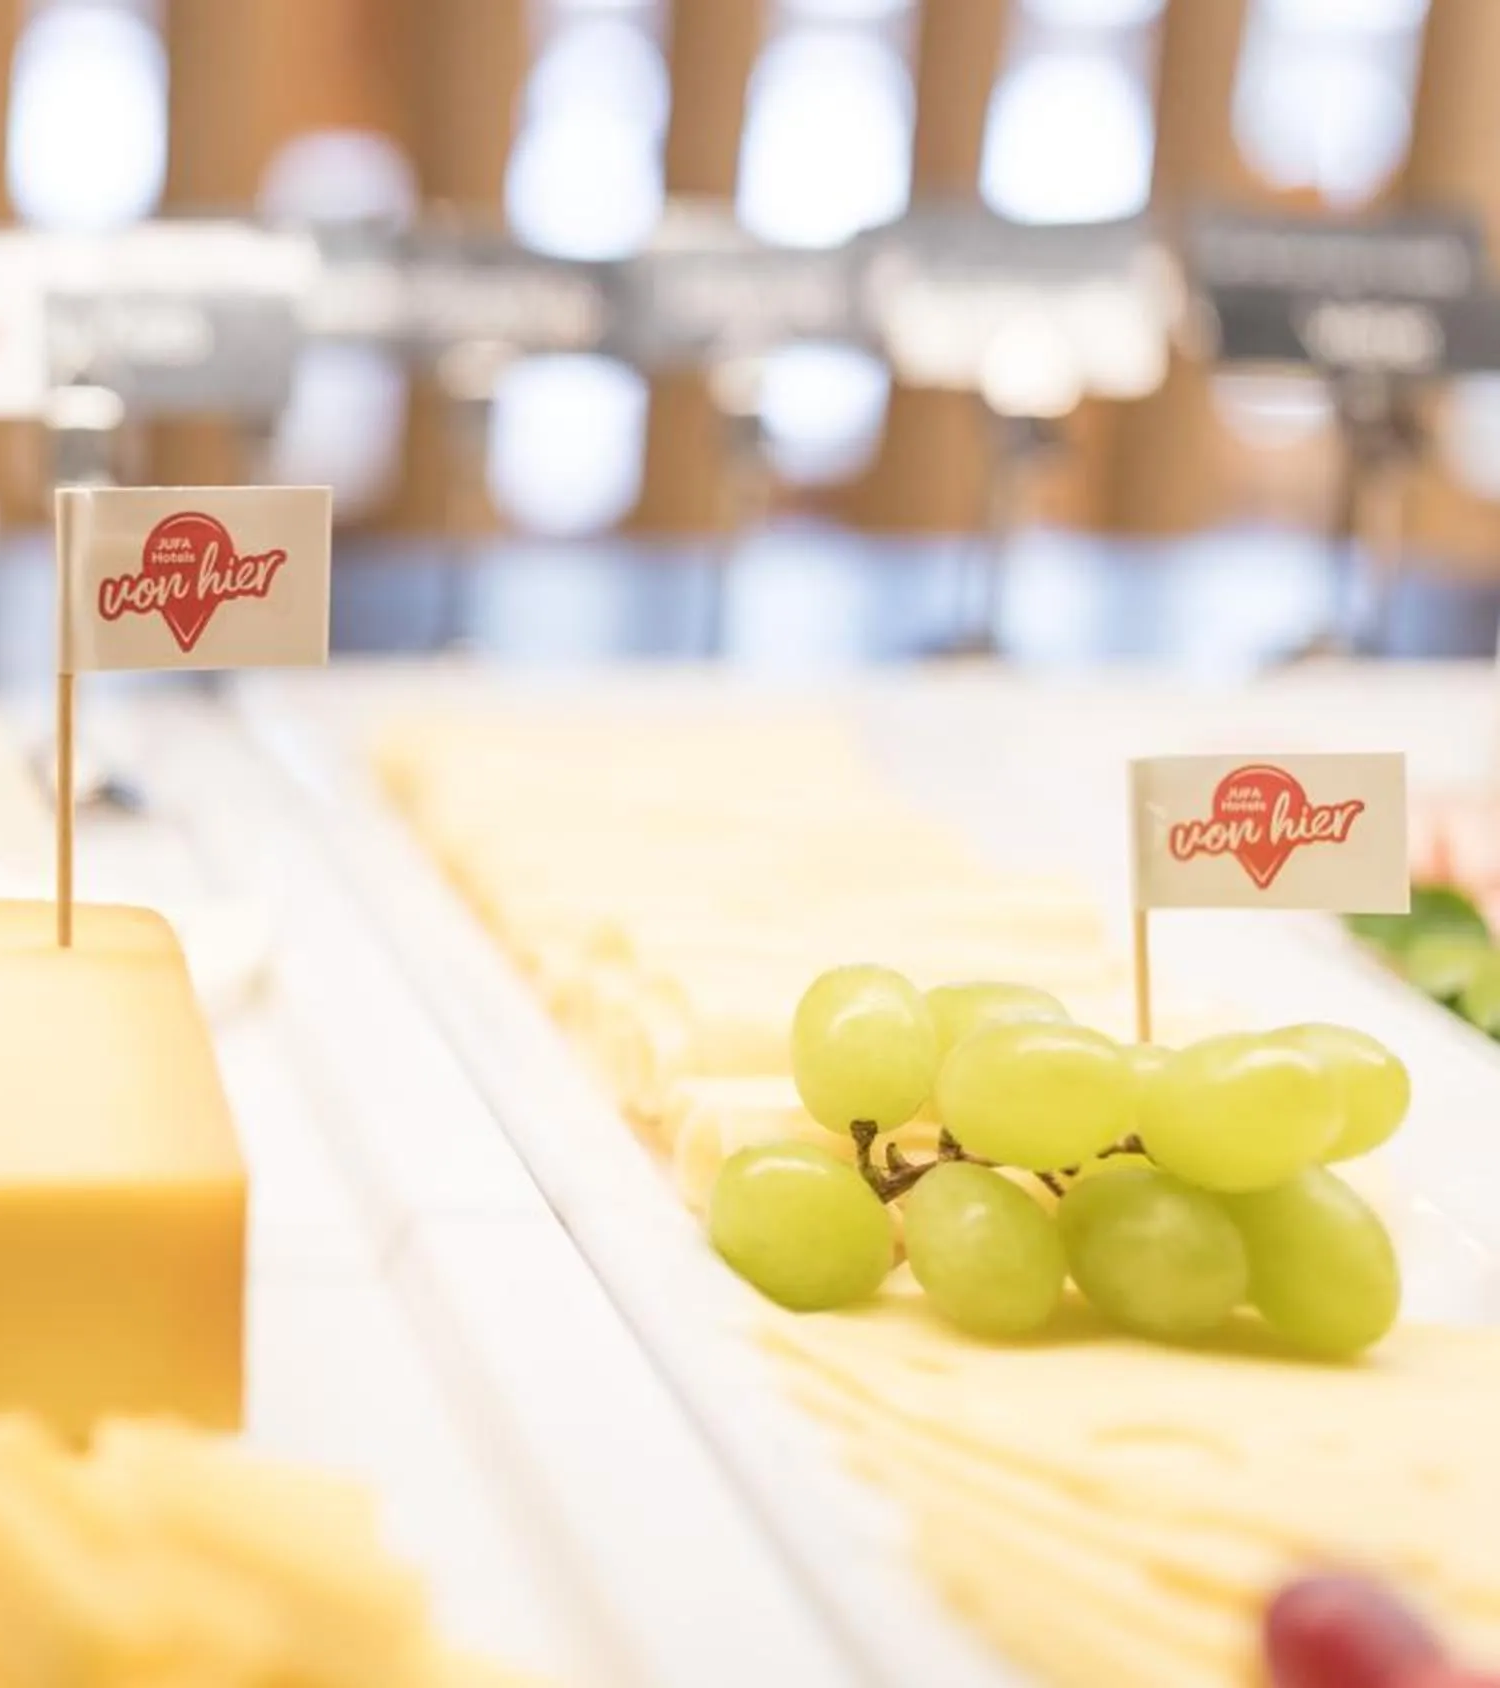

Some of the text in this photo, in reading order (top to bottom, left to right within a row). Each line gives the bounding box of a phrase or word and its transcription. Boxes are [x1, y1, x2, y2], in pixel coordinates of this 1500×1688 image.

[151, 551, 196, 565] Hotels
[156, 537, 192, 551] JUFA
[103, 541, 284, 615] von hier
[1174, 789, 1365, 856] von hier
